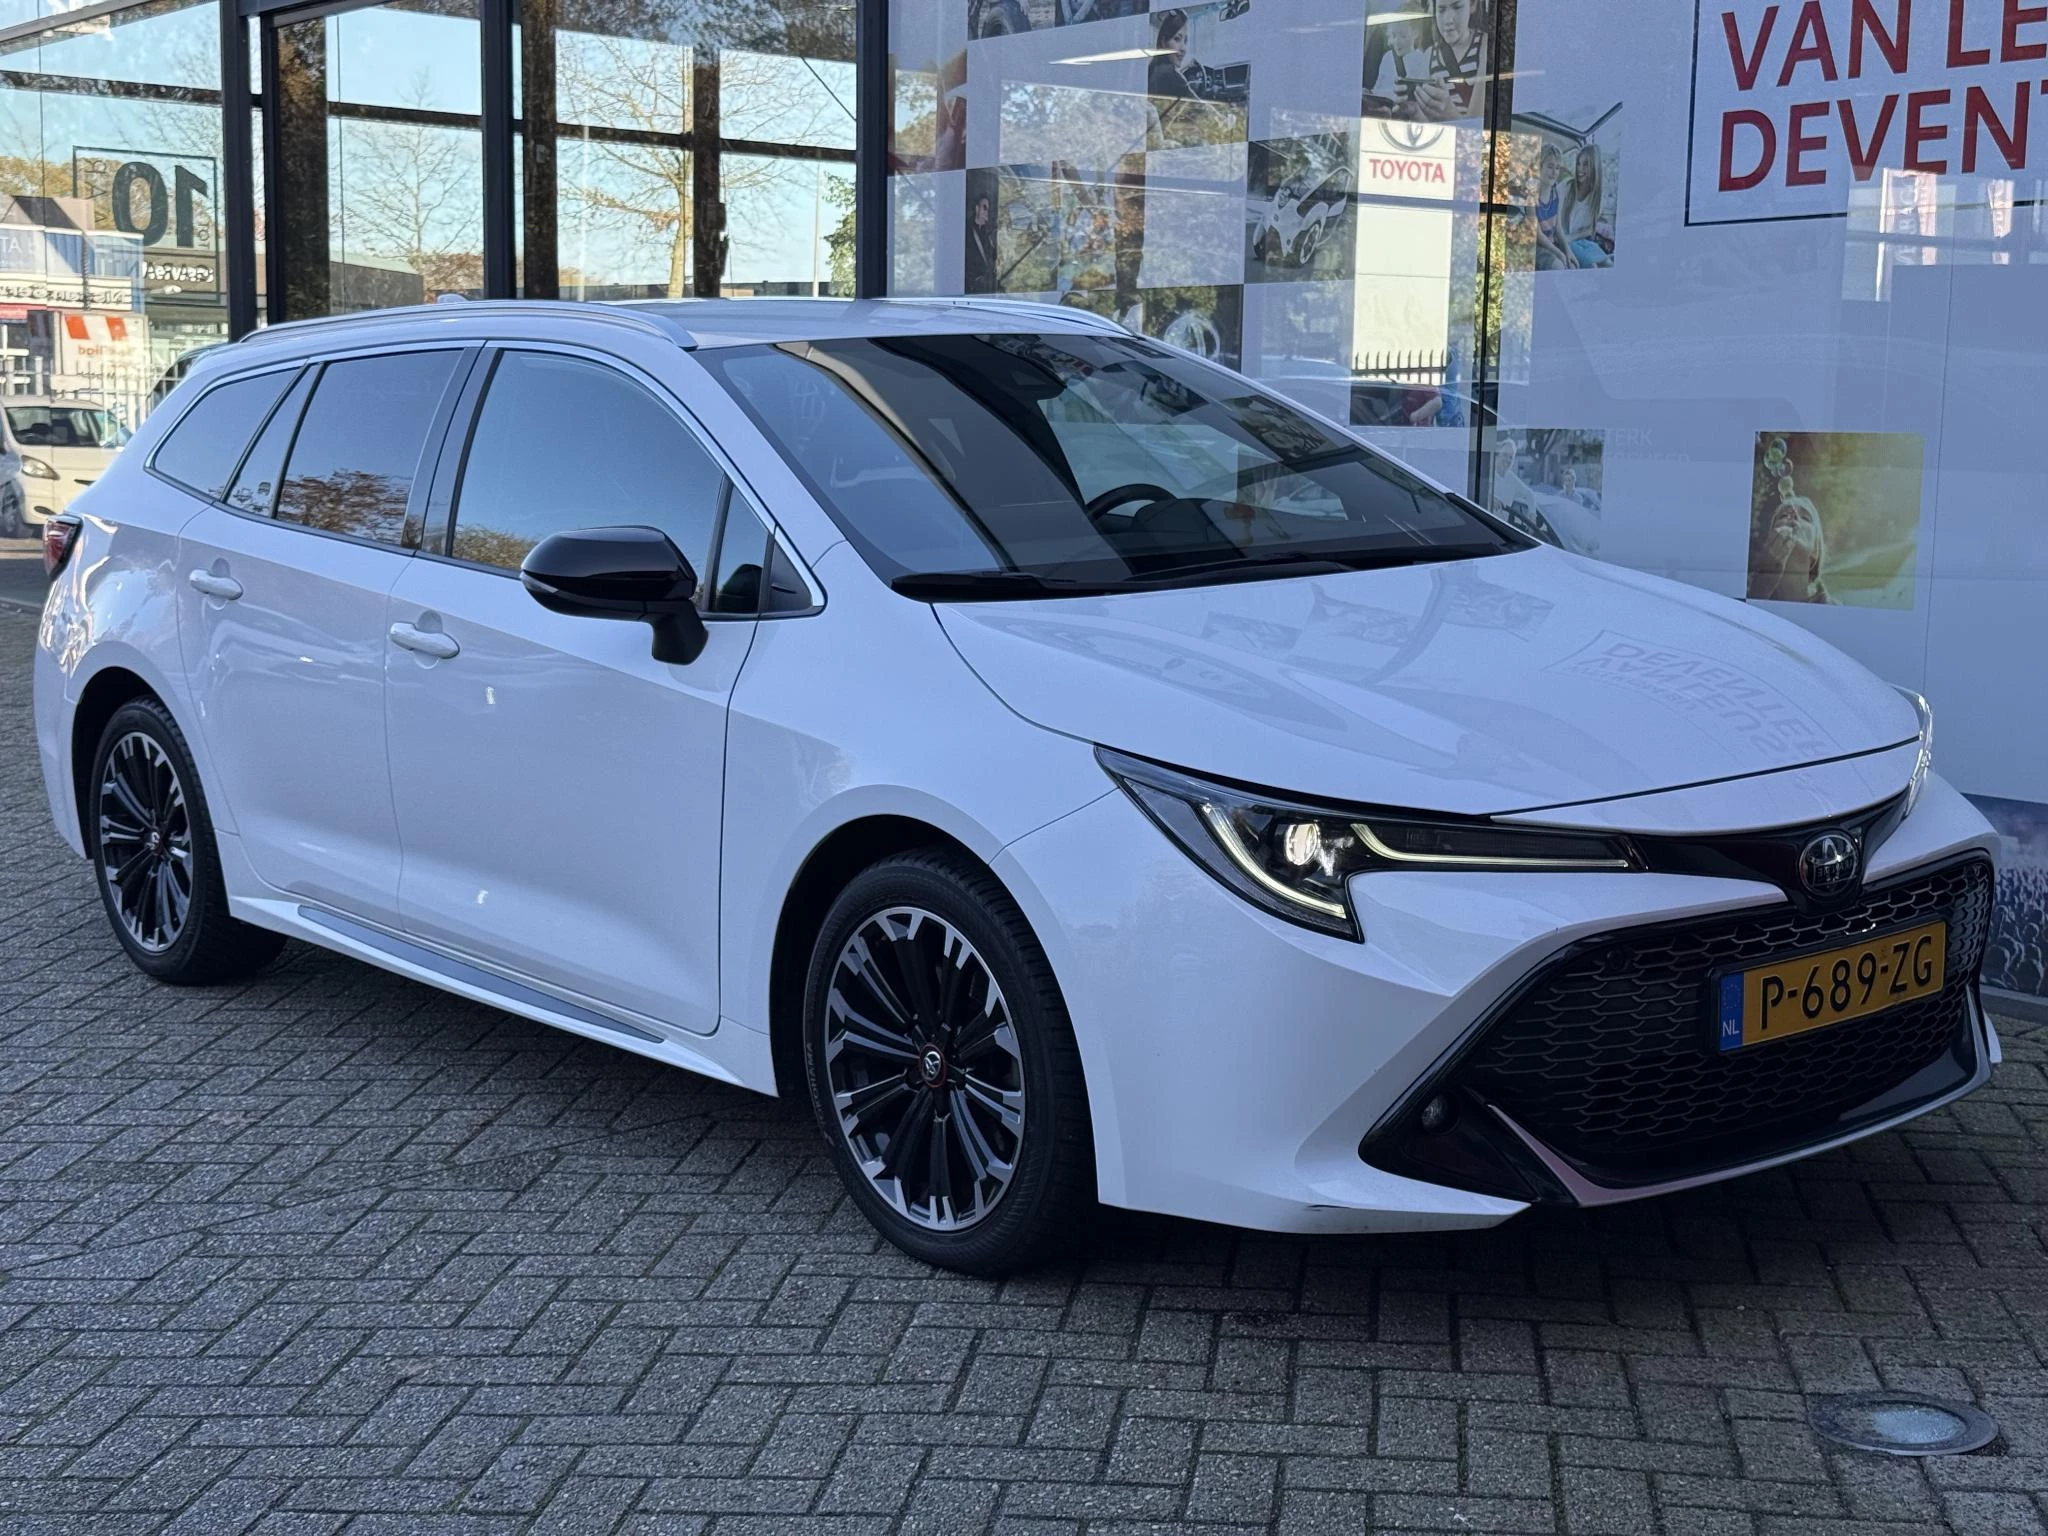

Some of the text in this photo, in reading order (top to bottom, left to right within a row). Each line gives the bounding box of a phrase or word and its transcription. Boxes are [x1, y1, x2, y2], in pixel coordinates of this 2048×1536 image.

[1721, 0, 1911, 91] VAN
[1369, 159, 1446, 183] TOYOTA
[1718, 80, 2048, 192] DEVEN
[1761, 934, 1932, 1030] P-689-ZG
[1722, 1019, 1740, 1037] NL
